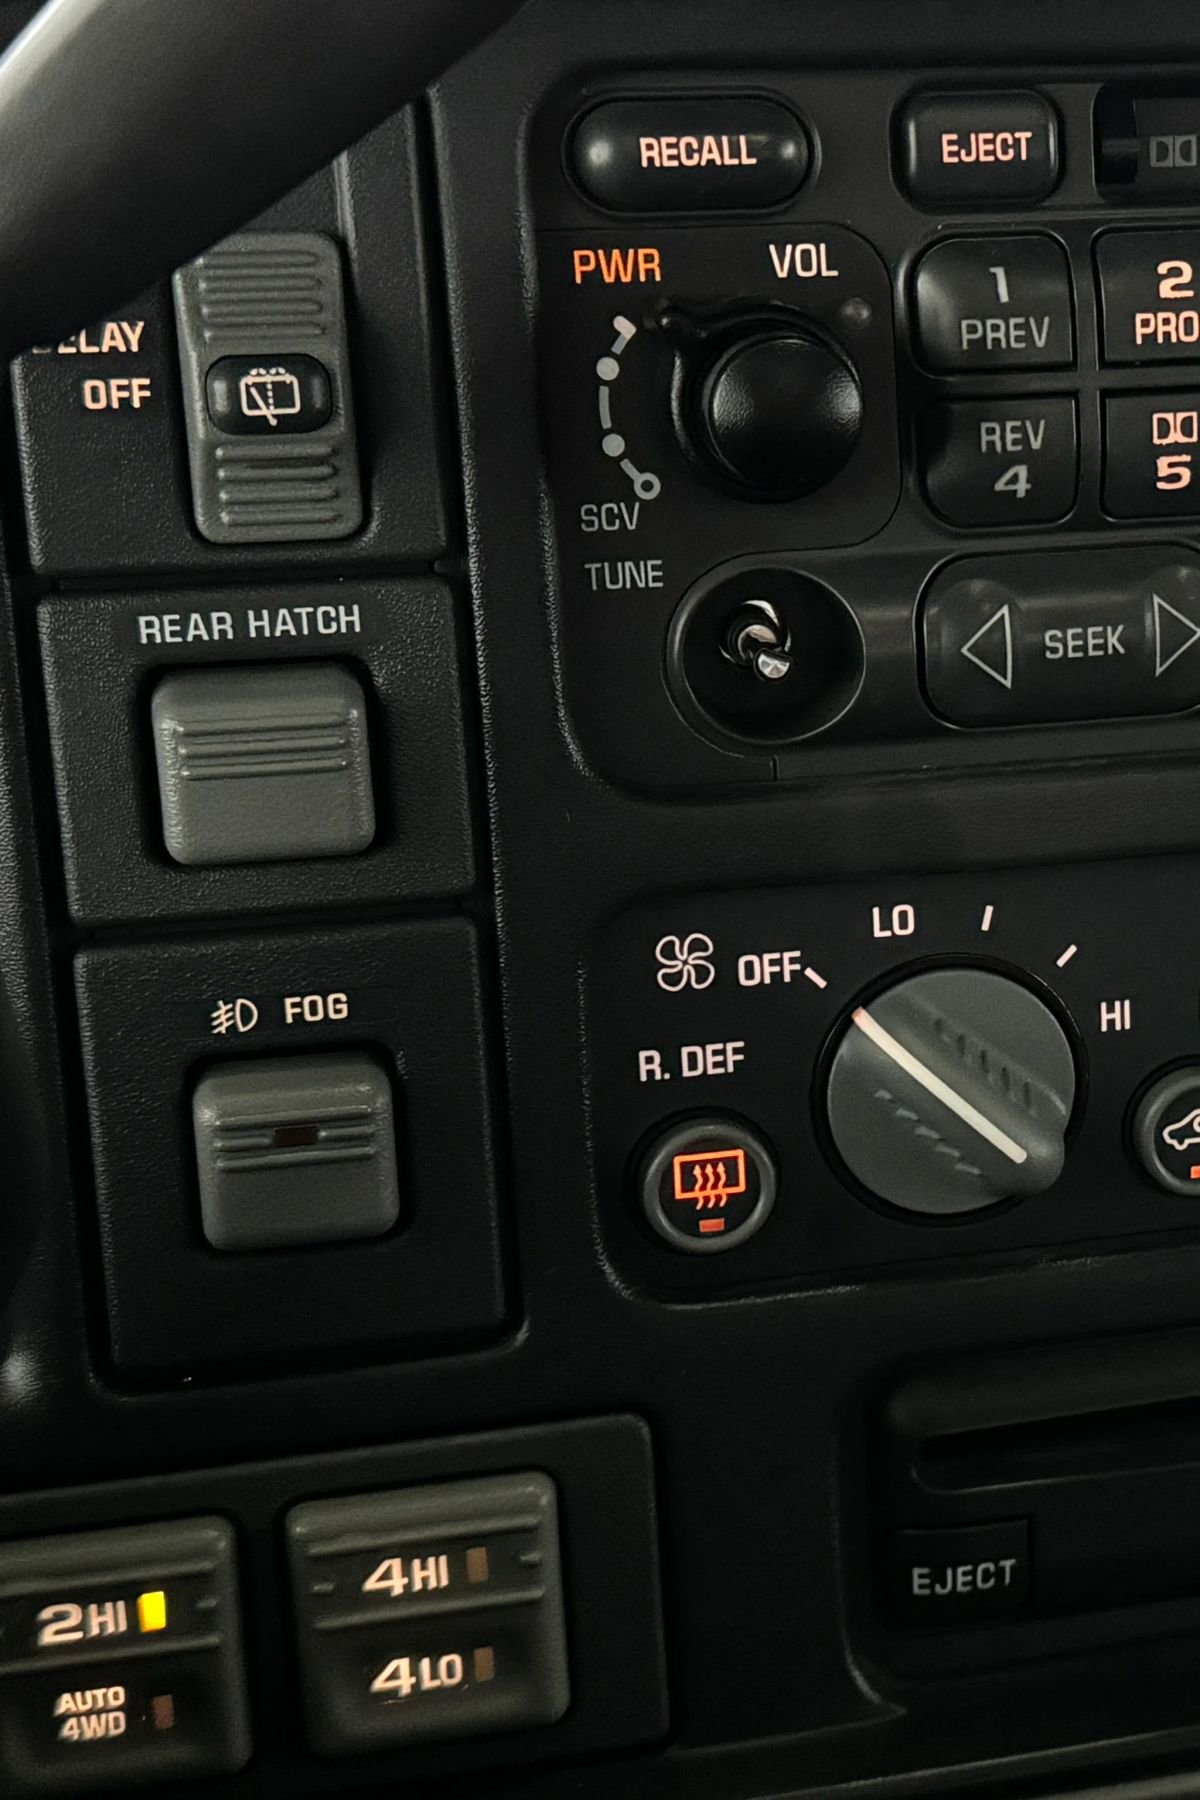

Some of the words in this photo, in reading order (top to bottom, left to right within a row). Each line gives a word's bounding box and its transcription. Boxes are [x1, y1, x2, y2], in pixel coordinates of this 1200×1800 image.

[639, 134, 757, 168] RECALL
[941, 131, 1033, 163] EJECT
[573, 248, 661, 284] PWR
[768, 243, 839, 278] VOL
[988, 266, 1009, 303] 1
[1156, 261, 1194, 299] 2
[32, 321, 145, 354] LAY
[960, 317, 1050, 350] PREV
[84, 378, 152, 410] OFF
[979, 420, 1046, 453] REV
[994, 465, 1031, 499] 4
[1155, 455, 1192, 490] 5
[580, 503, 640, 533] SCV
[584, 560, 664, 591] TUNE
[137, 611, 235, 645] REAR
[248, 605, 362, 641] HATCH
[1044, 625, 1126, 660] SEEK
[872, 903, 915, 938] LO
[737, 951, 801, 987] OFF
[283, 992, 349, 1024] FOG
[1101, 1000, 1132, 1032] HI
[638, 1049, 671, 1082] R.
[681, 1041, 745, 1076] DEF
[912, 1558, 1017, 1595] EJECT
[53, 1685, 126, 1717] AUTO
[58, 1710, 127, 1742] 4WD
